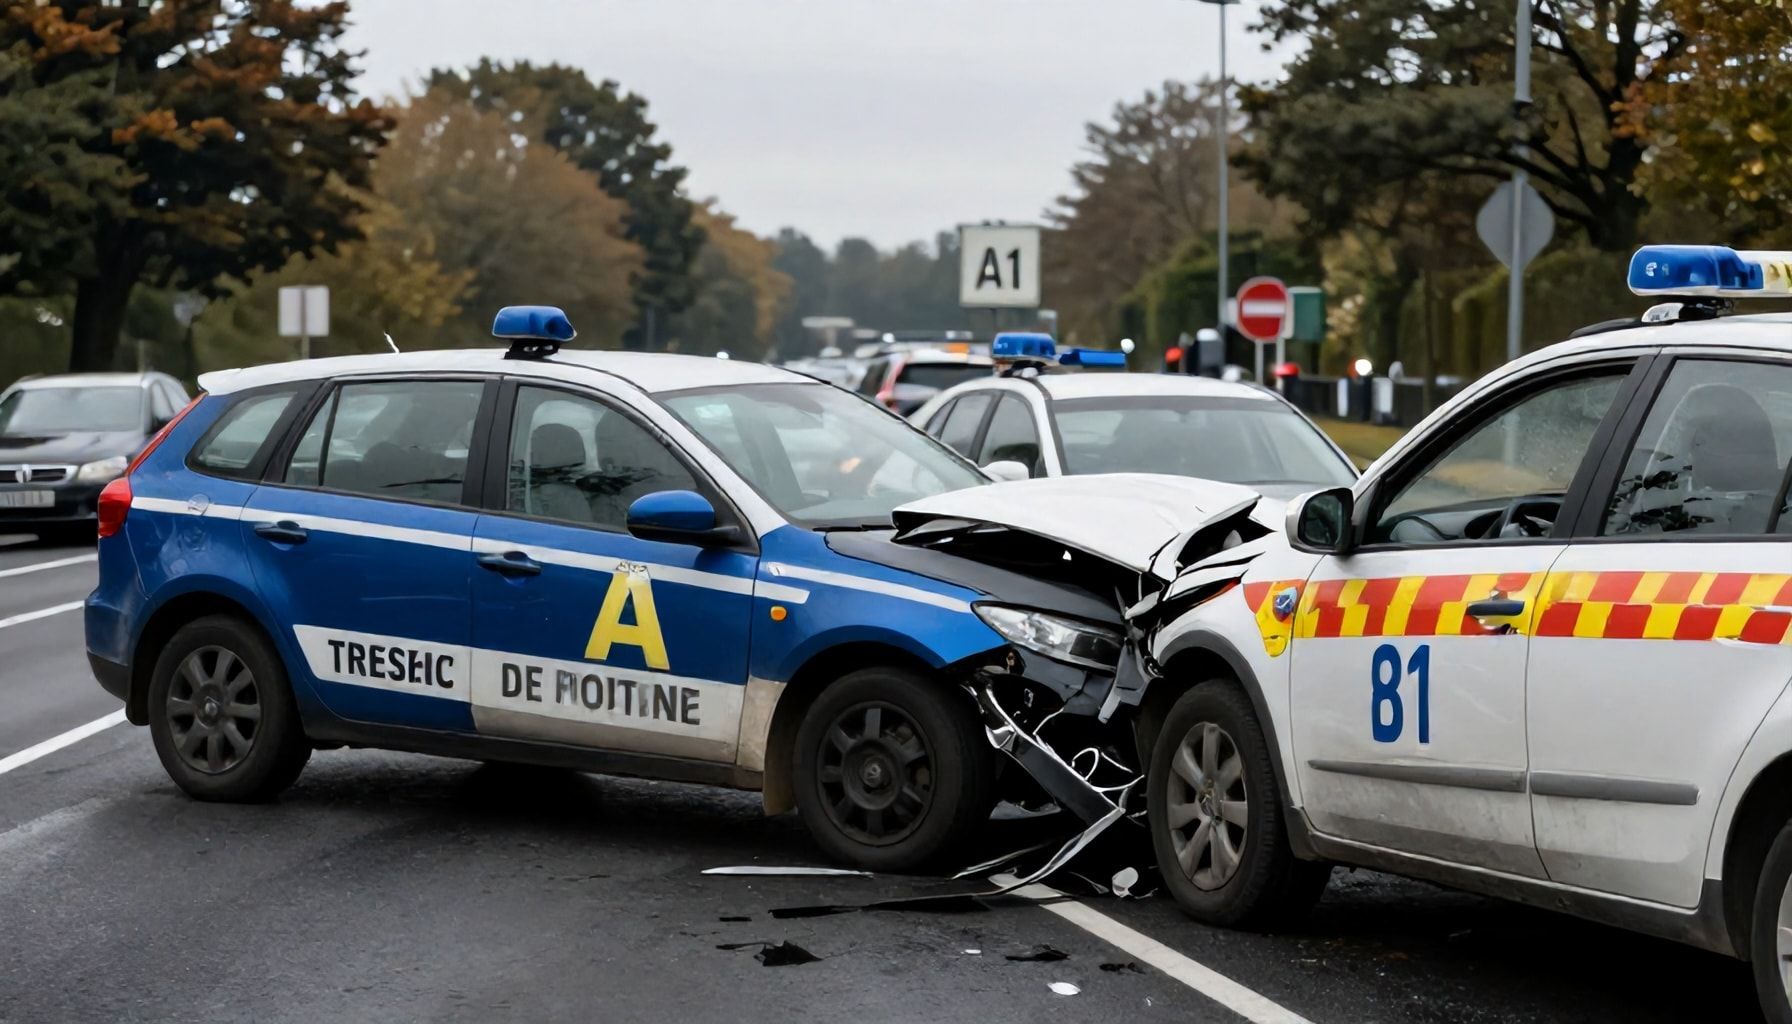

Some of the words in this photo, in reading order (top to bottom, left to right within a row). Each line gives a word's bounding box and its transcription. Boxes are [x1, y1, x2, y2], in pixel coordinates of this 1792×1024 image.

[976, 246, 1020, 290] A1
[584, 566, 670, 670] A
[502, 662, 543, 702] DE
[1371, 643, 1430, 744] 81
